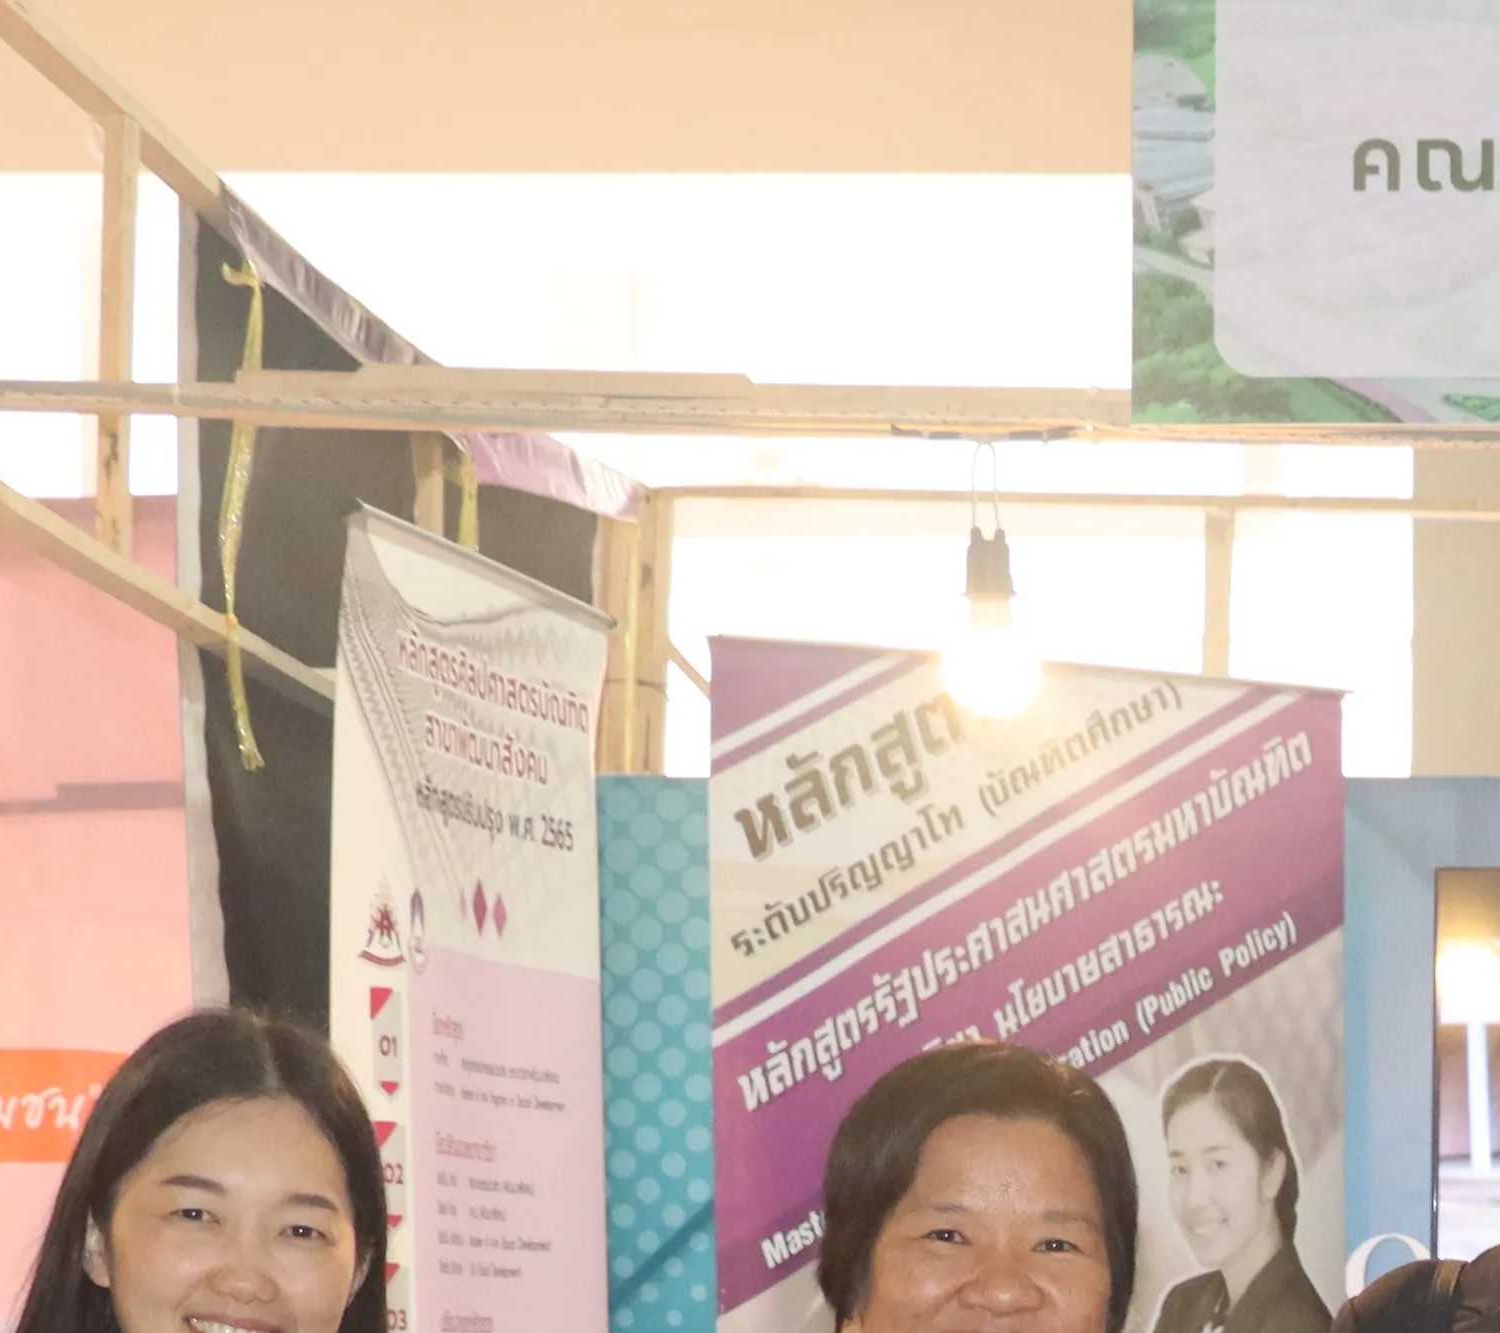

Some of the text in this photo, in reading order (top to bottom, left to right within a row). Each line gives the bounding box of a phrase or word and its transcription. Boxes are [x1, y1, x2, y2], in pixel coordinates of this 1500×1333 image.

[424, 712, 549, 786] สาขาพัฒนาสังคม
[541, 813, 574, 851] 2565
[730, 677, 1184, 959] ระดับปริญญาโท (บัณฑิตศึกษา)
[737, 731, 1314, 1114] หลักสูตรรัฐประศาสนศาสตรมหาบัณฑิต
[991, 879, 1224, 1038] นโยบายสาธารณะ
[1136, 965, 1214, 1034] (Public
[1219, 911, 1298, 977] Policy)
[378, 1034, 398, 1058] 01
